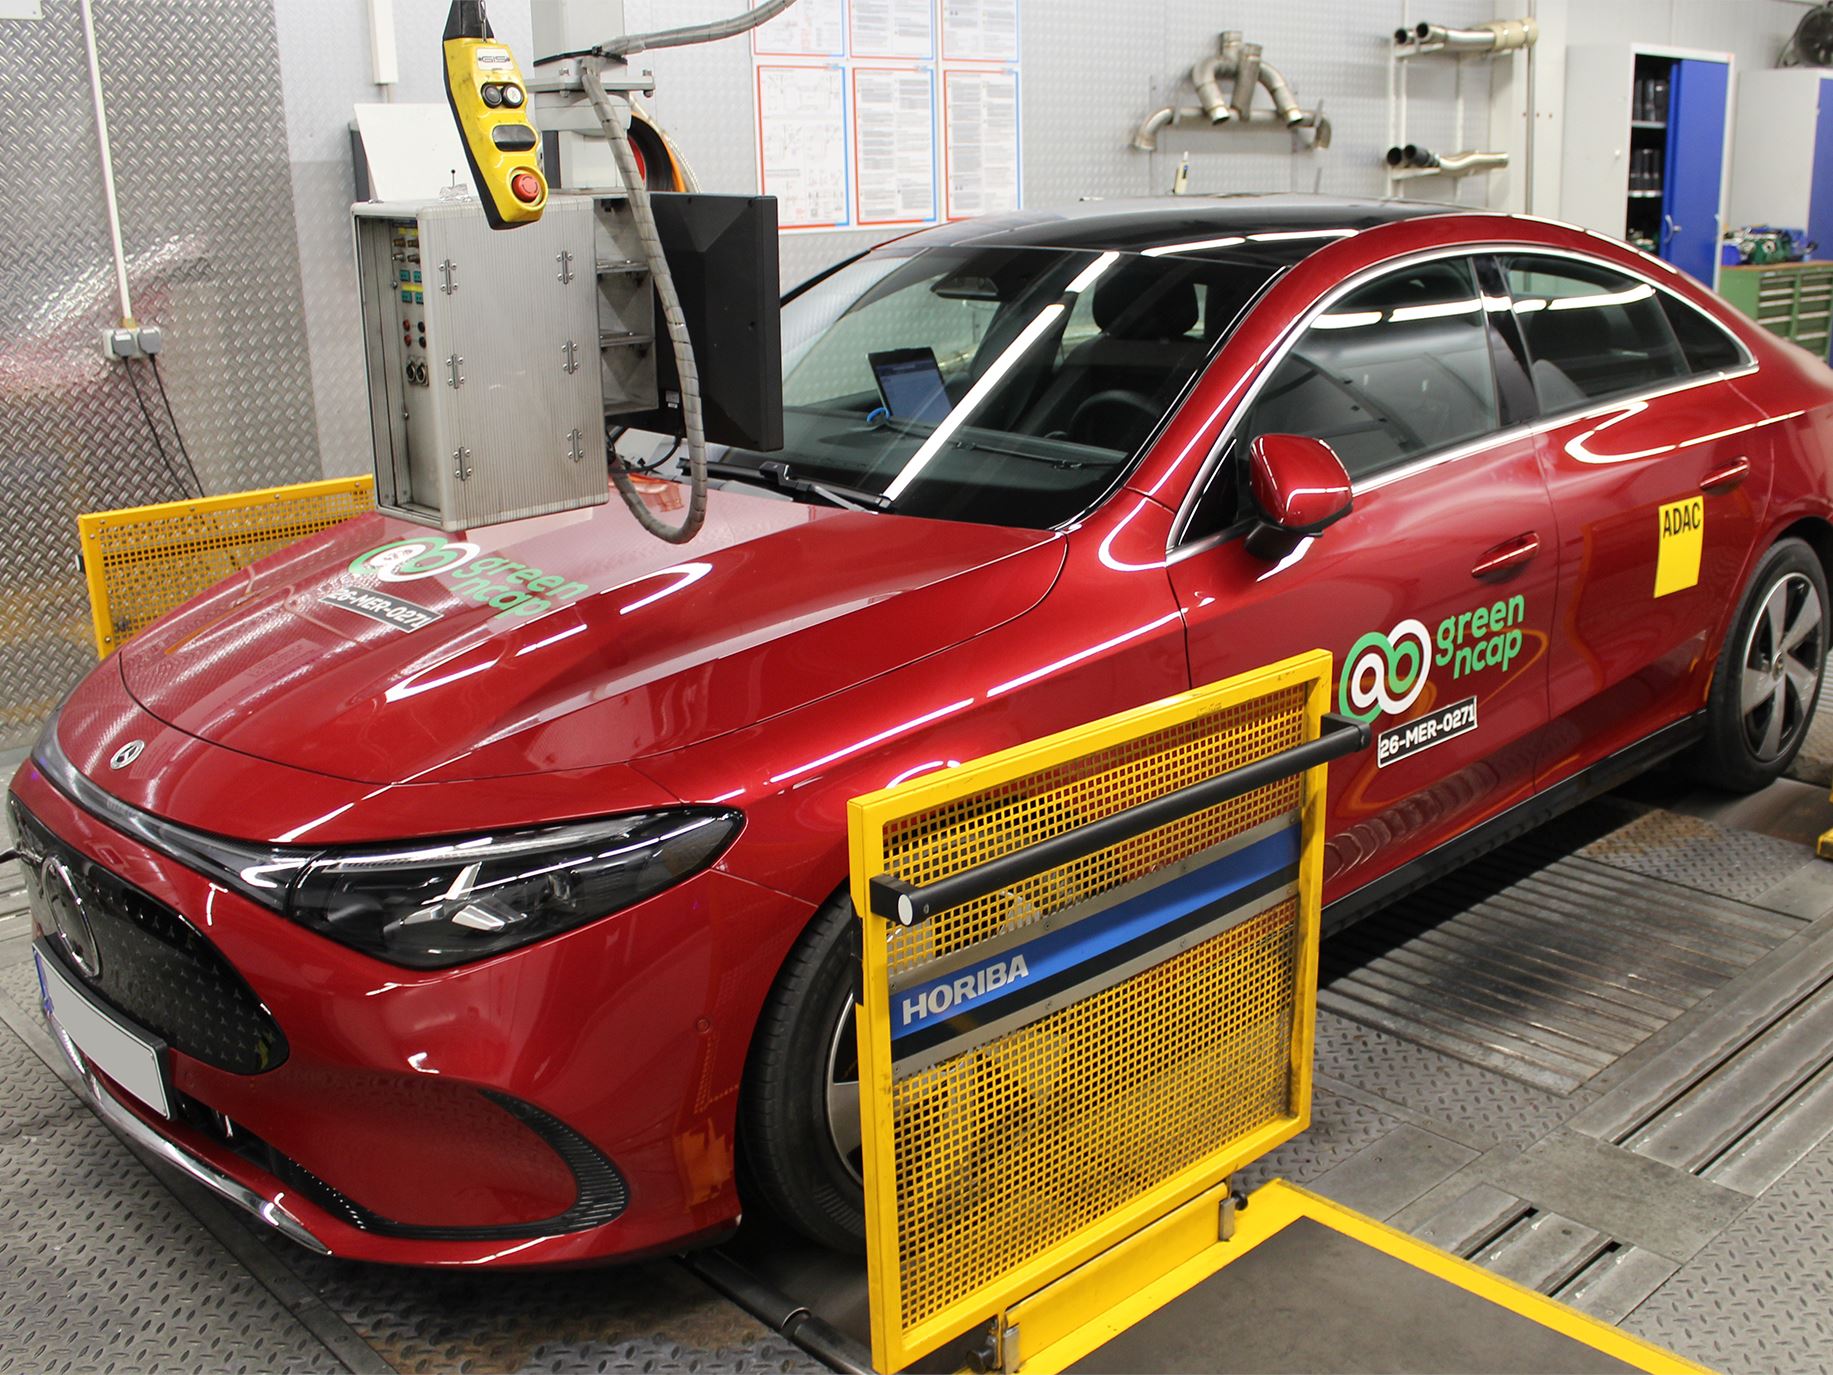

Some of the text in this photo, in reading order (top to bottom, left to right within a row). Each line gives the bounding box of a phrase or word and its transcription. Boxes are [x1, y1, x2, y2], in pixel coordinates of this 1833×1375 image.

[1663, 502, 1701, 539] ADAC
[449, 577, 552, 620] ncap
[452, 556, 588, 600] green
[331, 588, 432, 629] 26-MER-0271
[1436, 594, 1524, 666] green
[1454, 629, 1522, 679] ncap
[1380, 709, 1475, 759] 26-MER-0271
[902, 955, 1029, 1025] HORIBA
